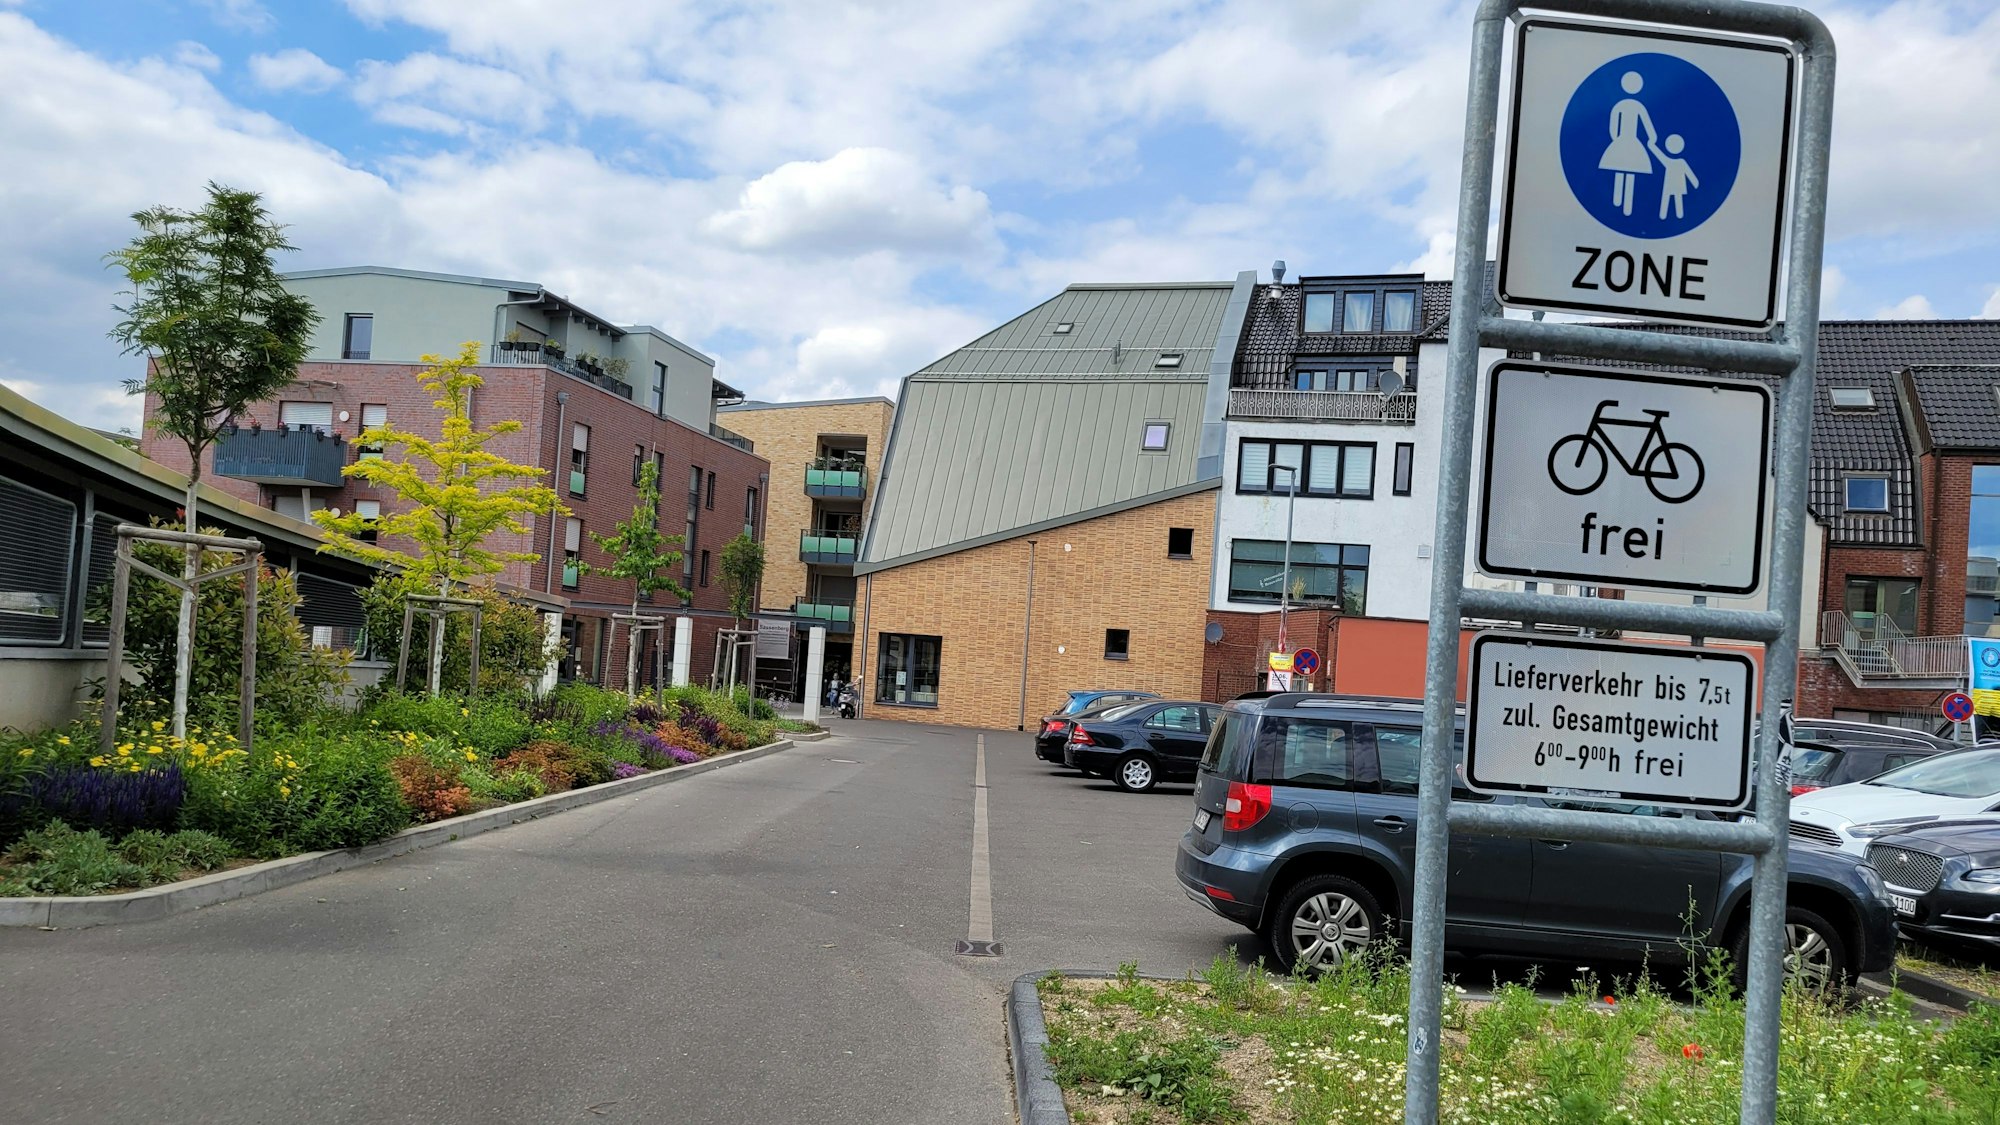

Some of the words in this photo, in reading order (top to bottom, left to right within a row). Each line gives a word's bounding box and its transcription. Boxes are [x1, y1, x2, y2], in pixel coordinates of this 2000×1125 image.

[1572, 247, 1709, 301] ZONE
[1581, 511, 1664, 560] frei
[1494, 661, 1644, 698] Lieferverkehr
[1656, 674, 1686, 701] bis
[1699, 677, 1731, 705] 7,5t
[1503, 702, 1540, 728] zul.
[1553, 704, 1719, 743] Gesamtgewicht
[1635, 749, 1684, 778] frei
[1895, 896, 1915, 913] 1100
